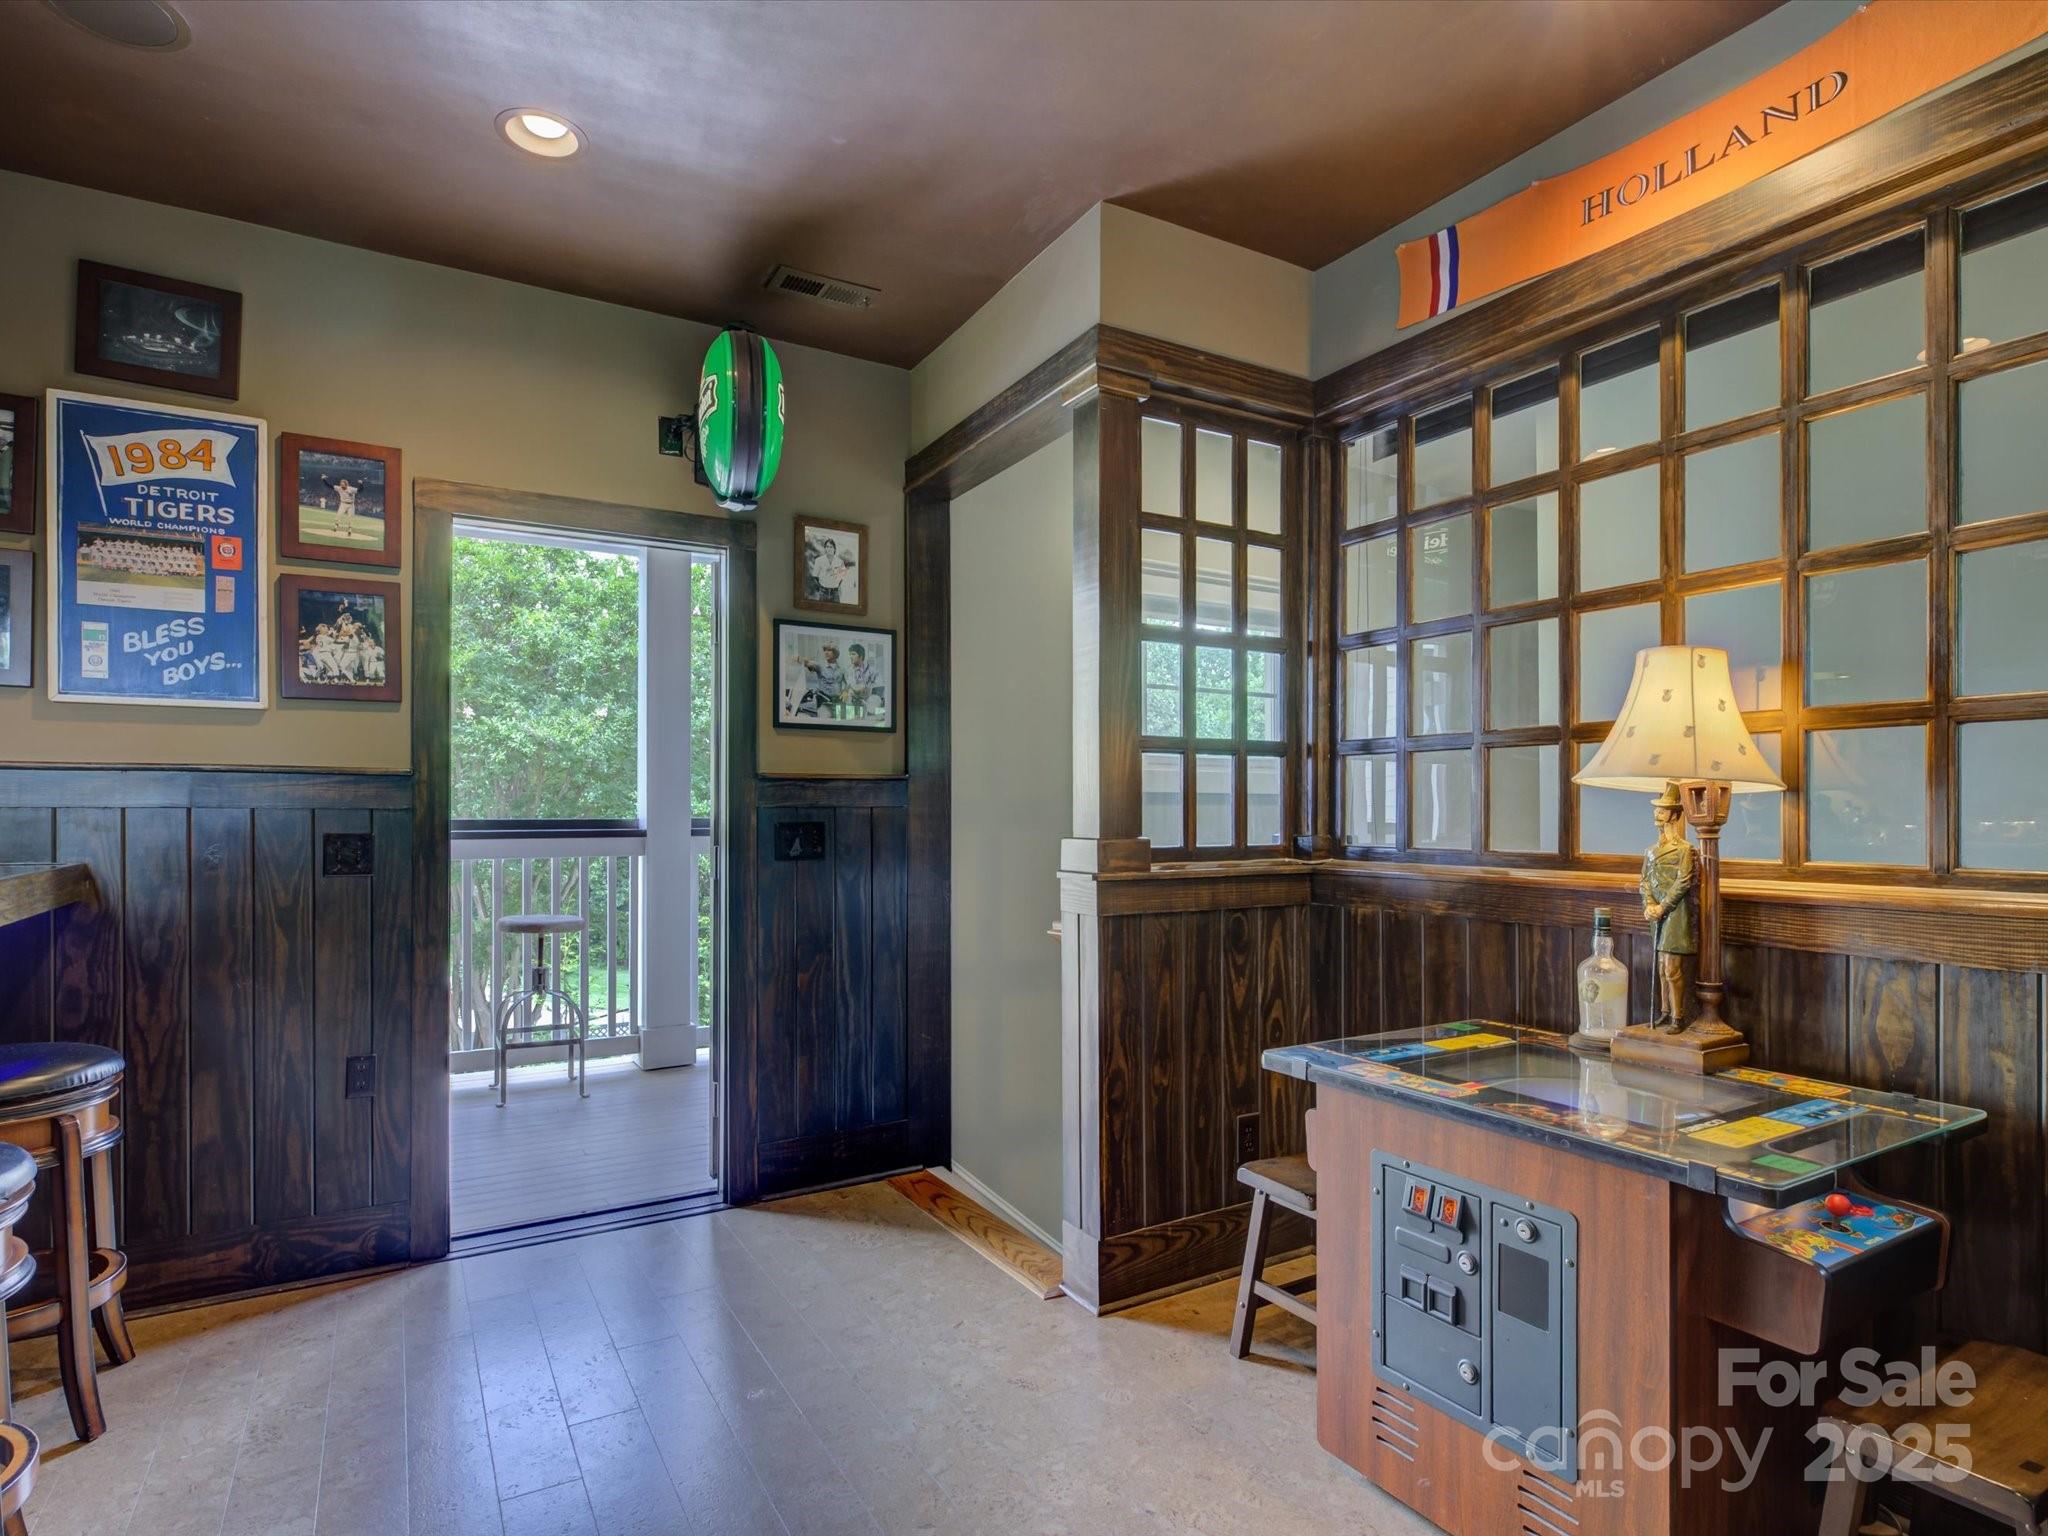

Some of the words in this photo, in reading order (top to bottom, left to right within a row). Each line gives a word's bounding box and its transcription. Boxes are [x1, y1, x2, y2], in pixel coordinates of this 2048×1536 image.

[1581, 70, 1849, 227] HOLLAND
[107, 438, 216, 477] 1984
[137, 484, 219, 502] DETROIT
[124, 497, 235, 525] TIGERS
[109, 517, 152, 528] WORLD
[157, 522, 226, 535] CHAMPIONS
[123, 617, 206, 652] BLESS
[144, 640, 194, 666] YOU
